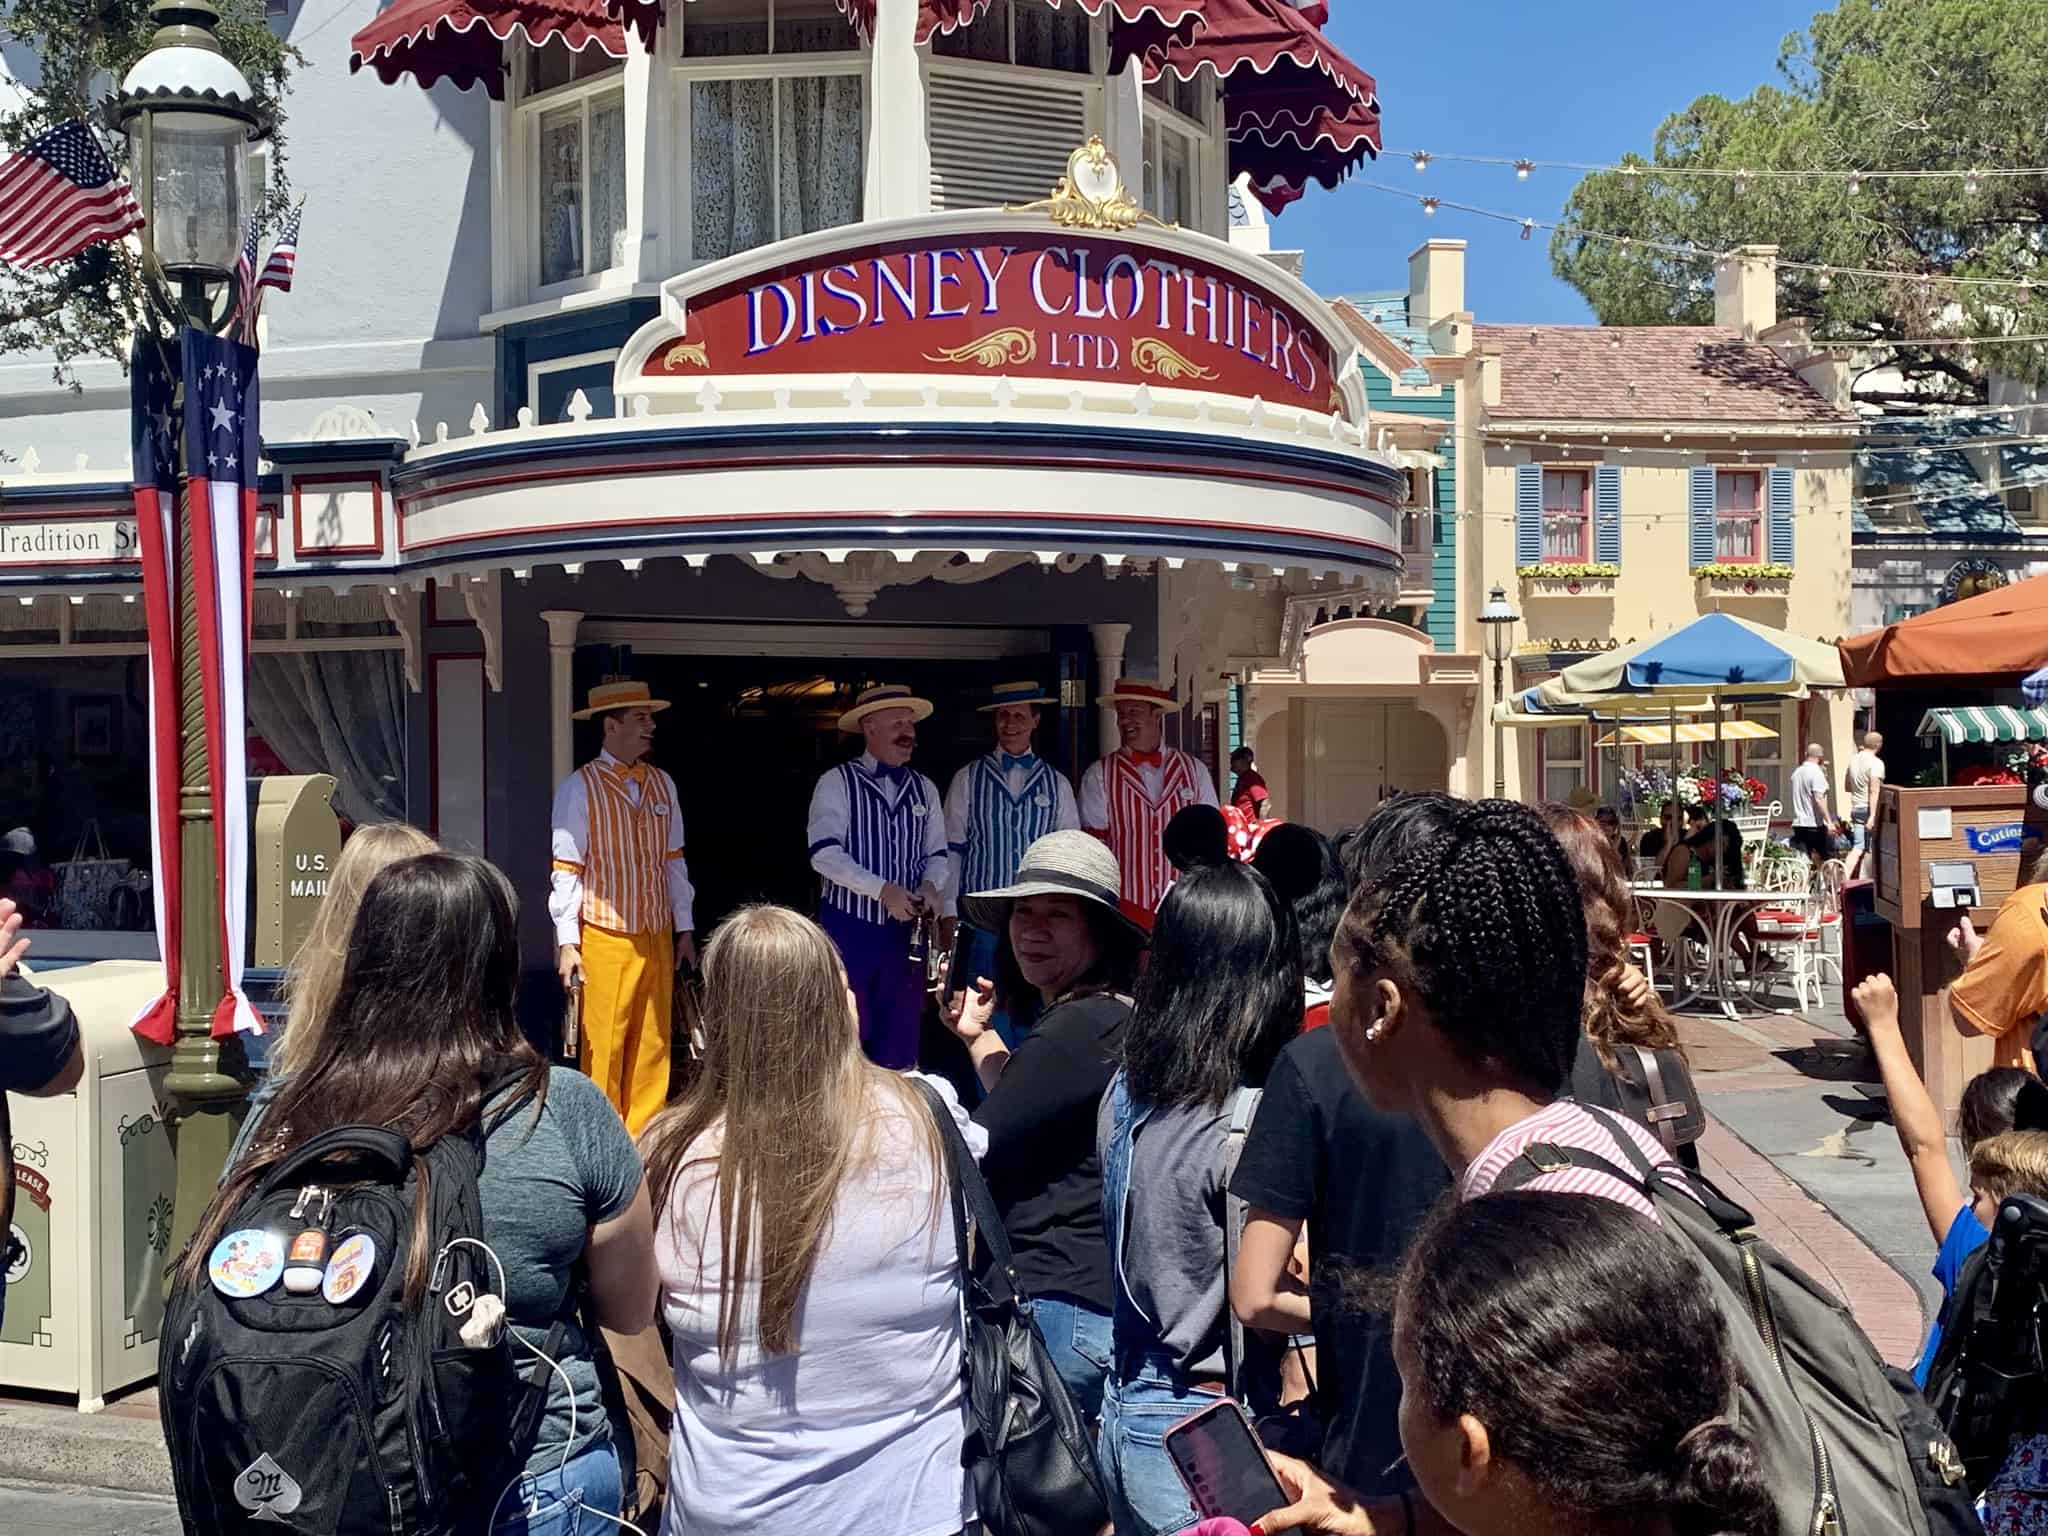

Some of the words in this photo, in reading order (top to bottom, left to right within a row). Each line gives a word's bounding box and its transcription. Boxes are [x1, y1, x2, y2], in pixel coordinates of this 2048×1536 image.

[744, 246, 1017, 358] DISNEY
[1029, 246, 1316, 392] CLOTHIERS
[0, 525, 100, 553] Tradition
[114, 520, 137, 550] Si
[295, 853, 329, 872] U.S.
[290, 879, 328, 898] MAIL
[15, 1168, 45, 1193] LEASE
